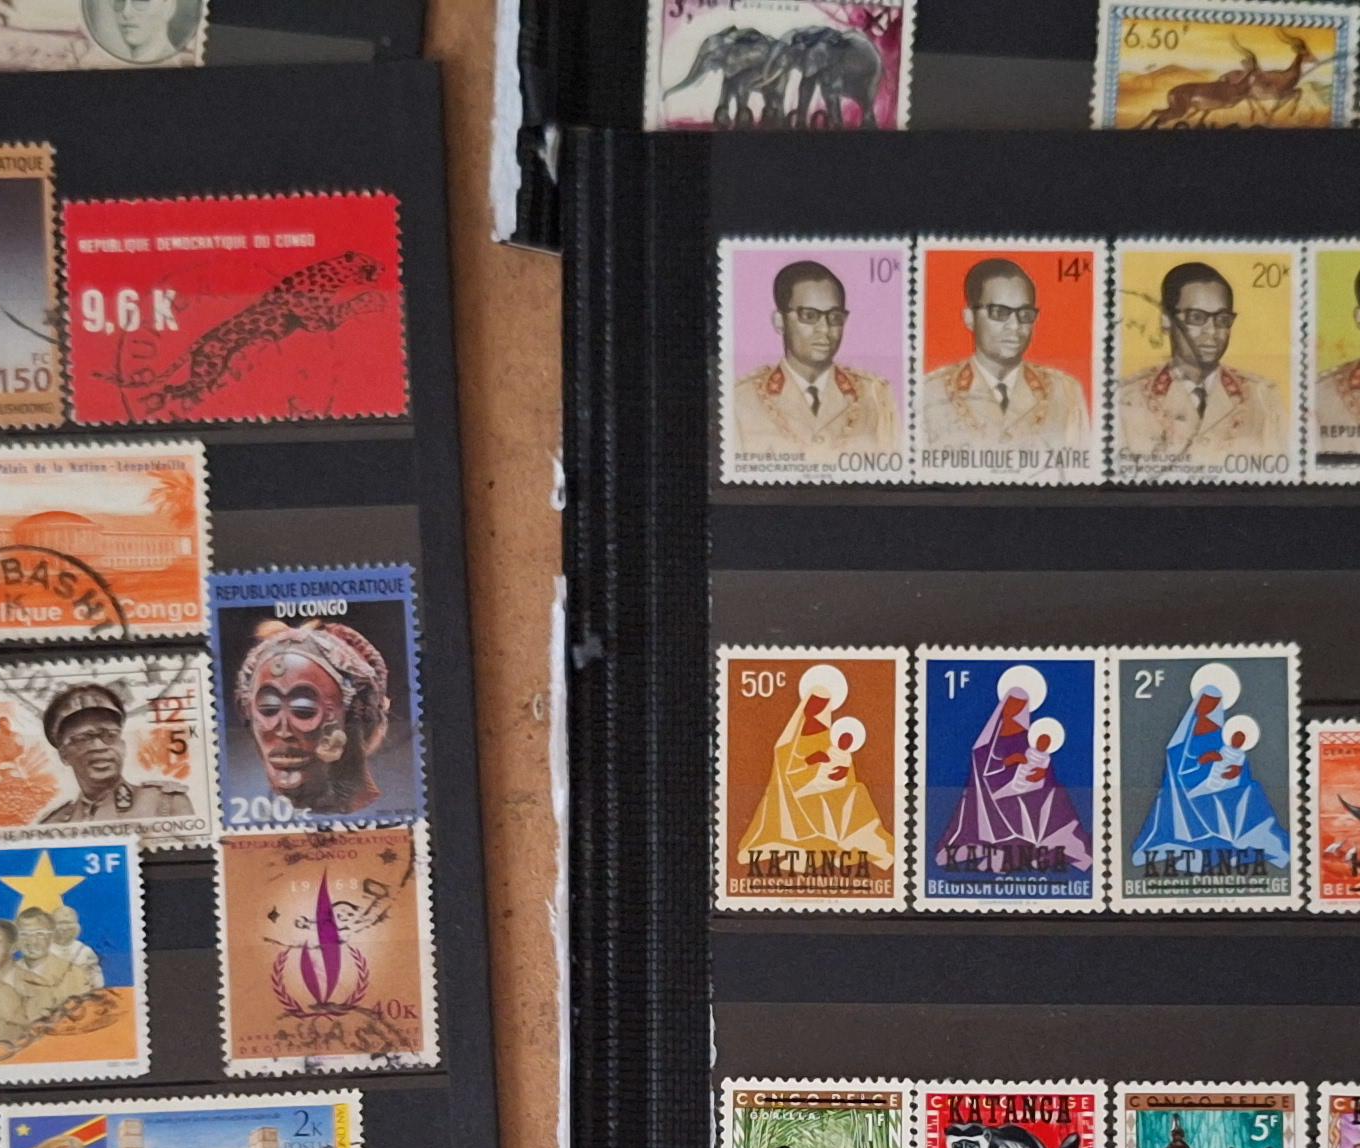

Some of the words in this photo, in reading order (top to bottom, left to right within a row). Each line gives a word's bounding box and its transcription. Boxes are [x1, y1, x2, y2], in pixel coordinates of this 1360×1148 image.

[78, 238, 149, 253] REPUBLIQUE
[157, 235, 246, 252] DEMOCRATIQUE
[254, 234, 270, 248] DU
[275, 233, 315, 248] CONGO
[154, 290, 178, 331] K
[839, 452, 904, 474] CONGO
[922, 450, 1013, 471] REPUBLIQUE
[1020, 450, 1040, 469] DU
[1224, 452, 1290, 475] CONGO
[216, 584, 296, 600] REPUBLIQUE
[301, 579, 403, 597] DEMOCRATIQUE
[121, 599, 197, 624] Congo
[275, 601, 296, 618] DU
[298, 599, 347, 616] CONGO
[747, 849, 870, 879] KATANGA
[1143, 848, 1268, 877] KATANGA
[949, 1096, 1071, 1125] KATANGA
